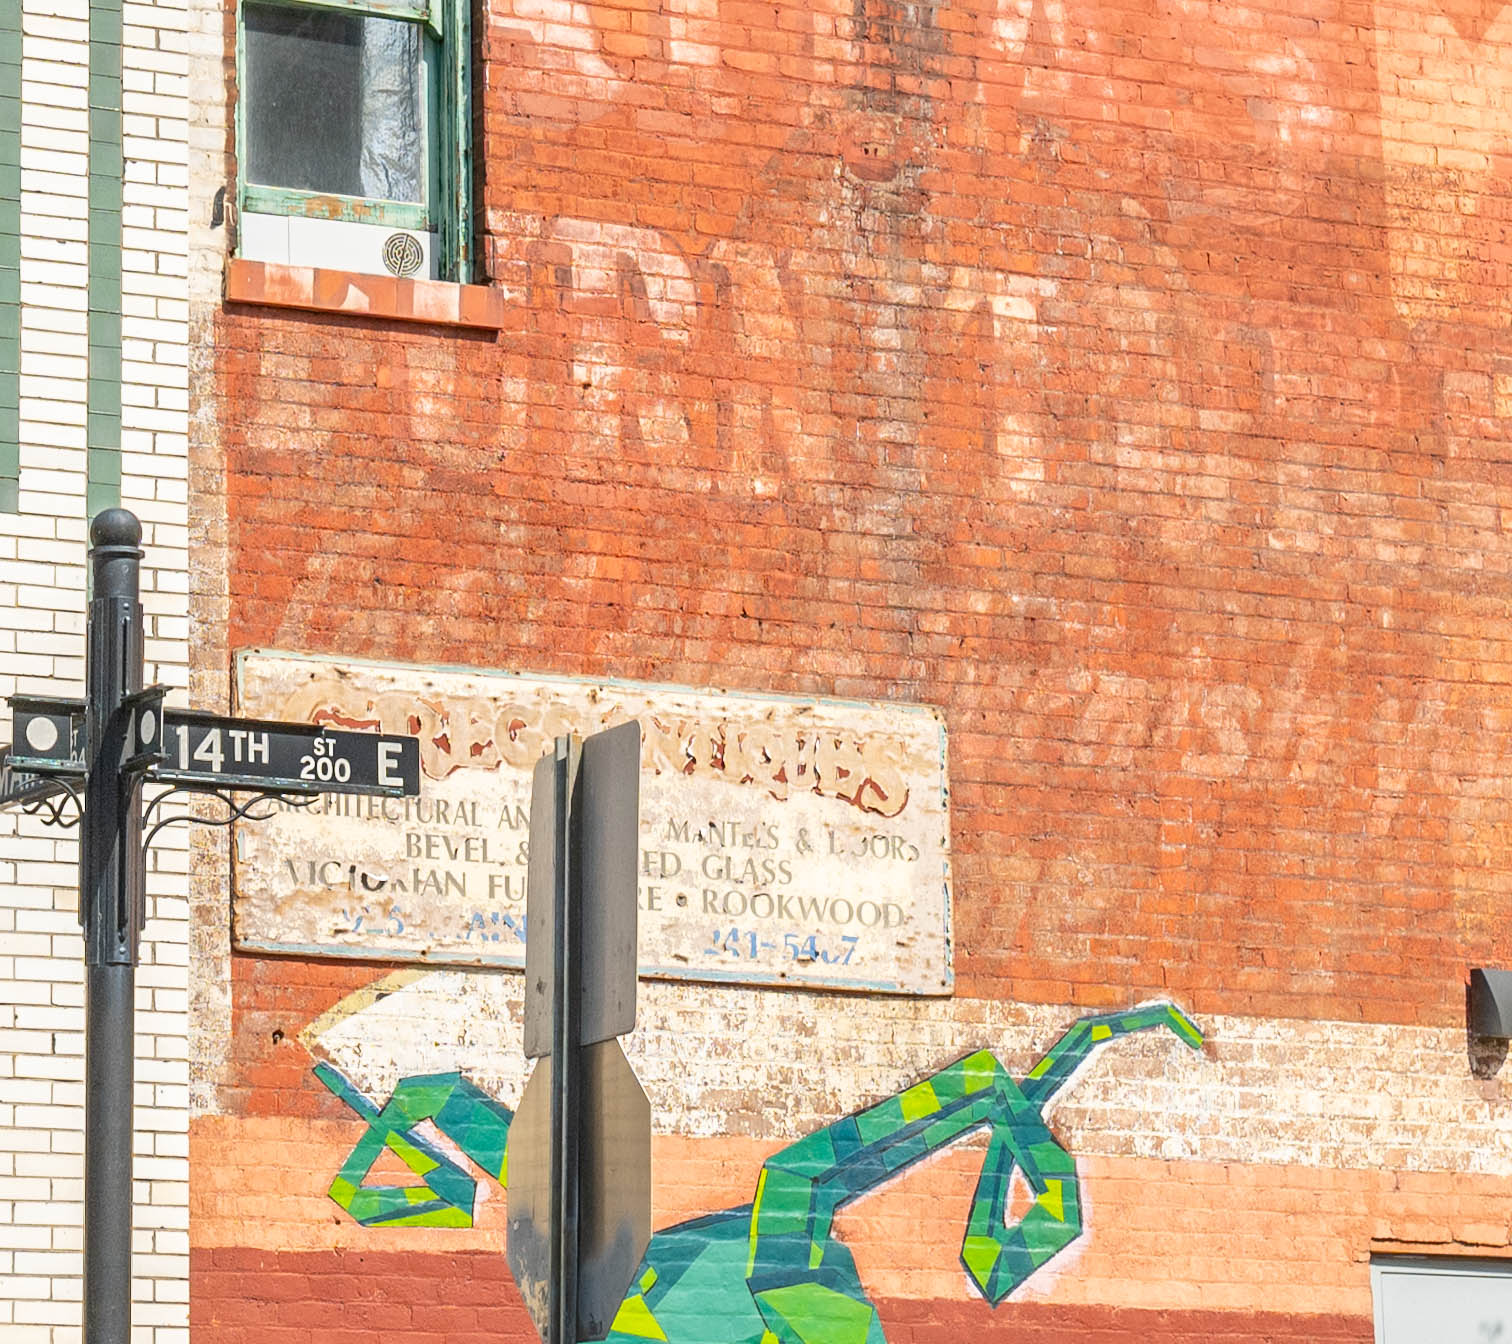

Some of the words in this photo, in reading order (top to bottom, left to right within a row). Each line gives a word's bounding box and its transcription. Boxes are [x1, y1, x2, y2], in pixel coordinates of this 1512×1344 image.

[176, 725, 270, 773] 14TH
[313, 737, 337, 758] ST
[377, 741, 405, 788] E
[299, 755, 352, 784] 200
[796, 827, 814, 855] &
[701, 854, 793, 885] GLASS
[701, 887, 905, 929] ROOKWOOD
